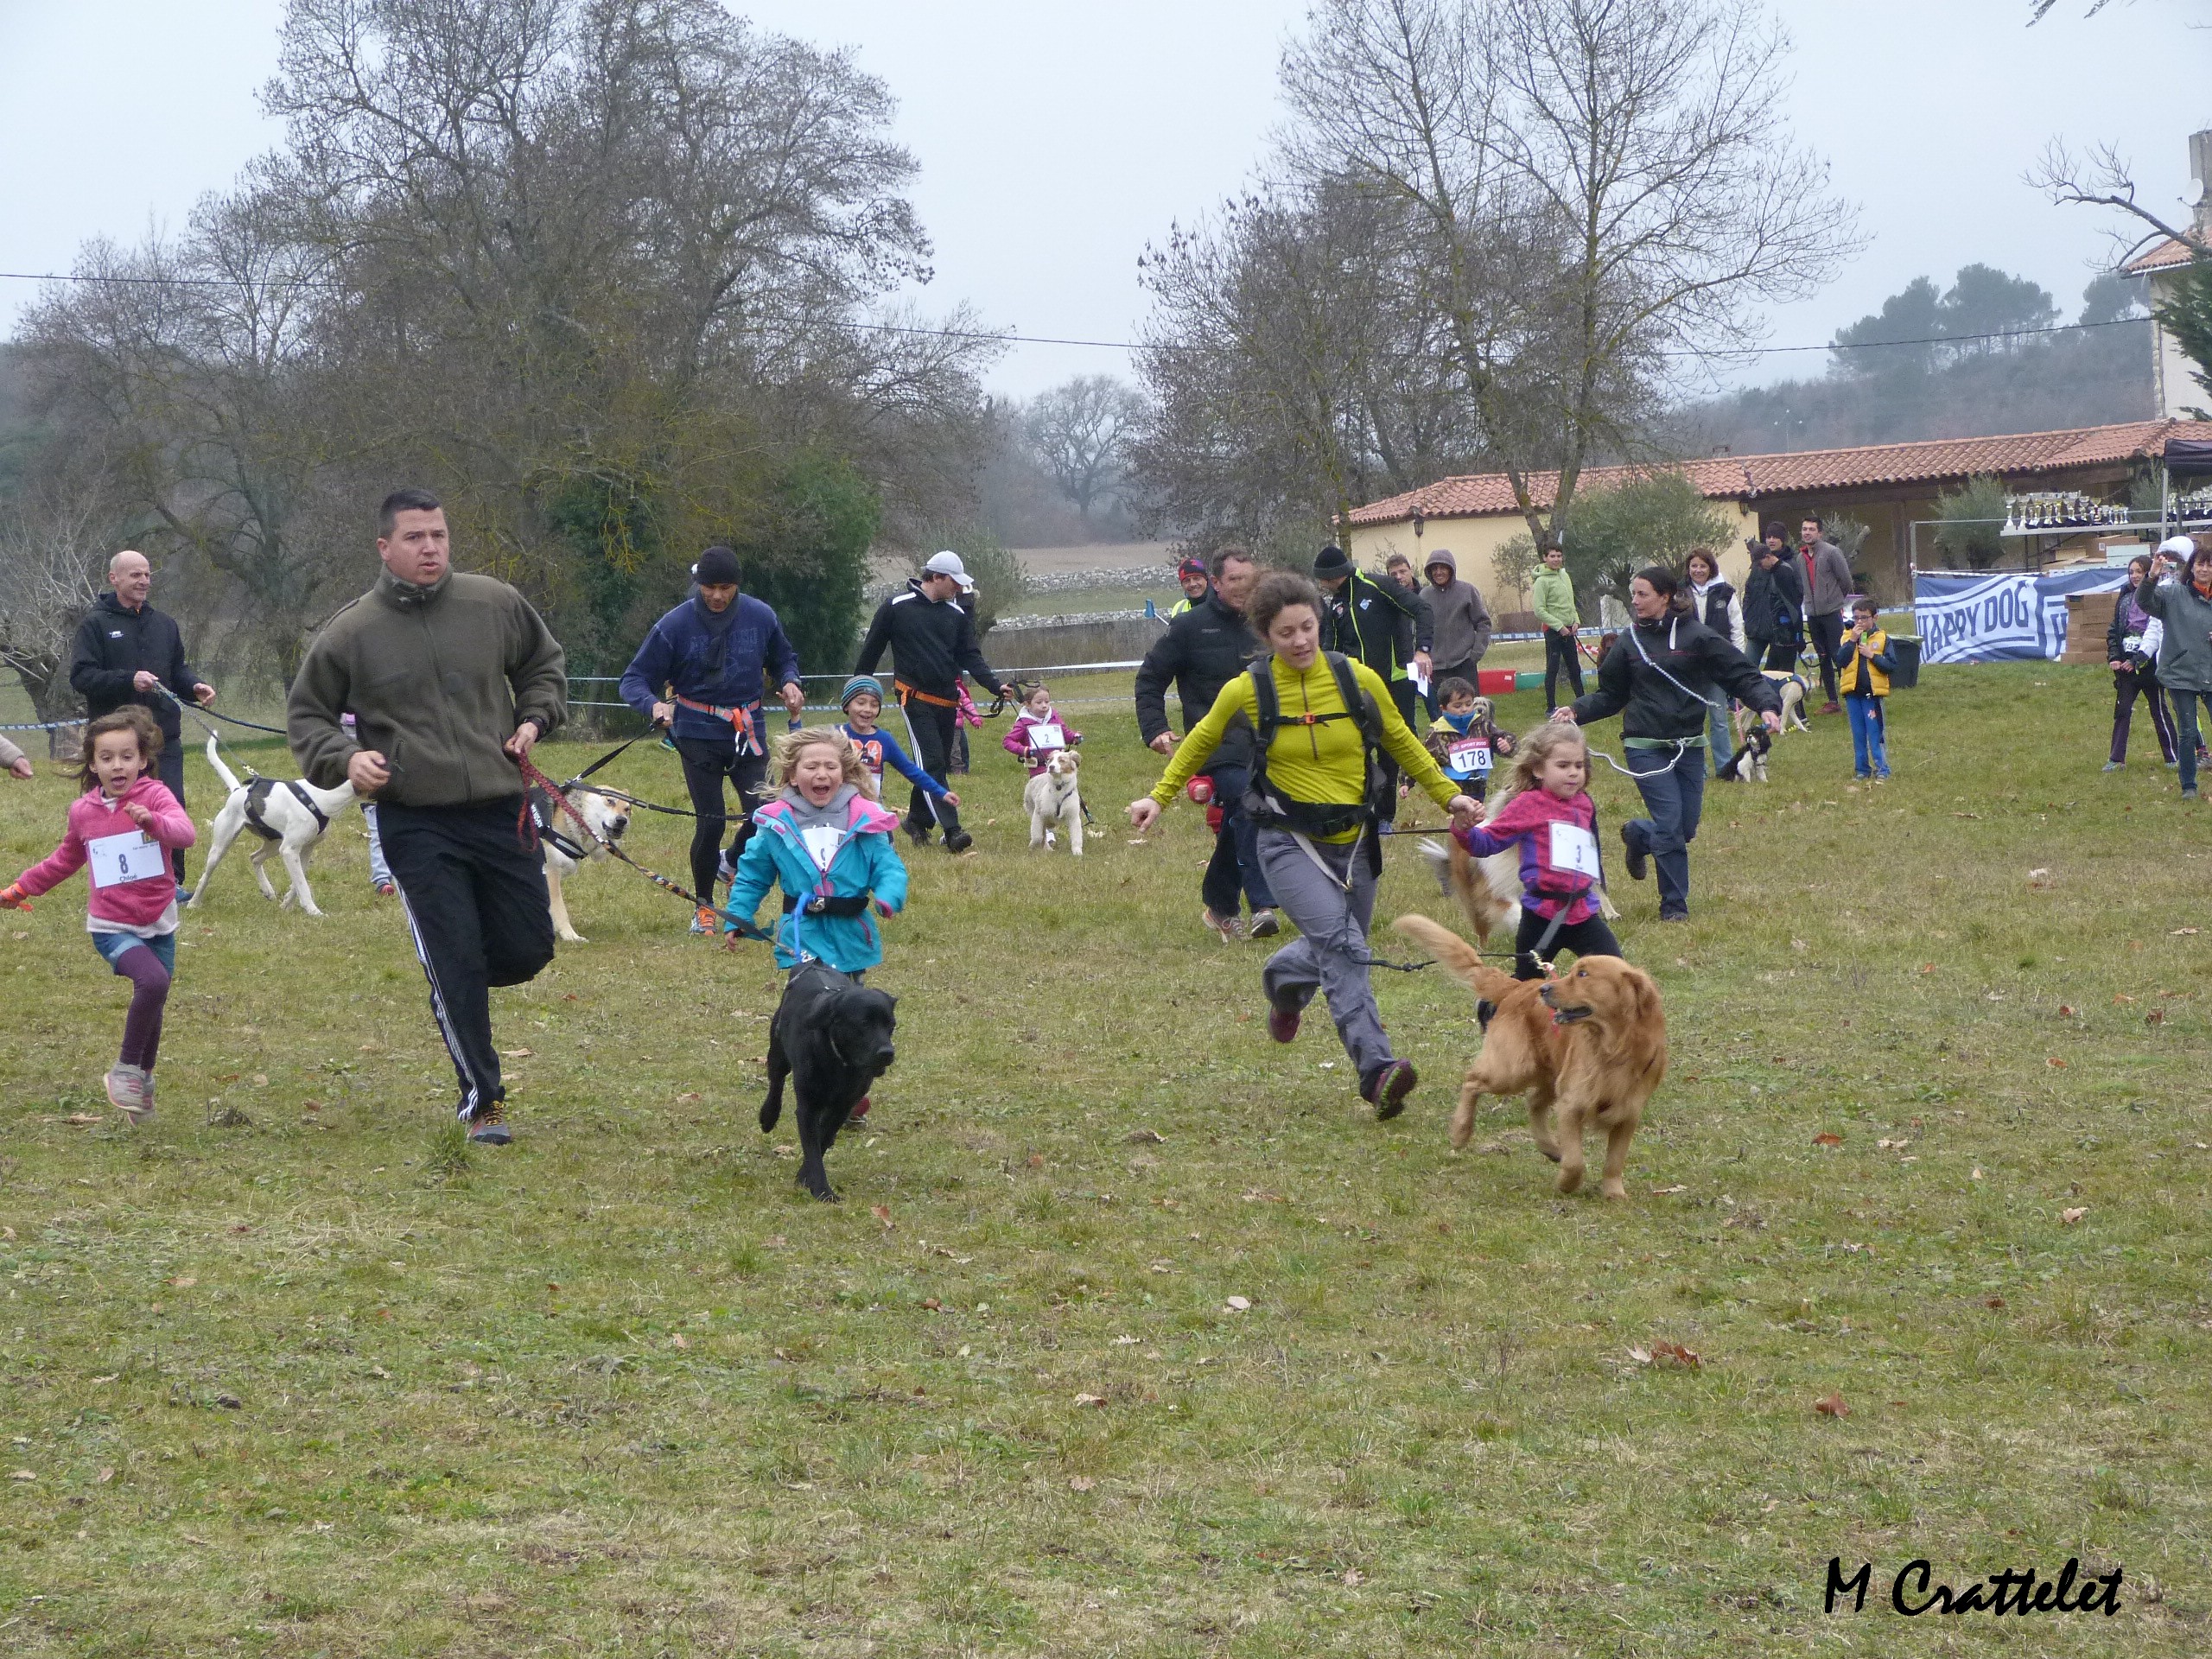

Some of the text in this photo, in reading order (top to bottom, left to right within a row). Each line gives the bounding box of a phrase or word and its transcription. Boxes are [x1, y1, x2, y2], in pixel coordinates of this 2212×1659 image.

[1917, 579, 2029, 664] HAPPY DOG
[1459, 750, 1486, 768] 178
[118, 854, 129, 874] 8
